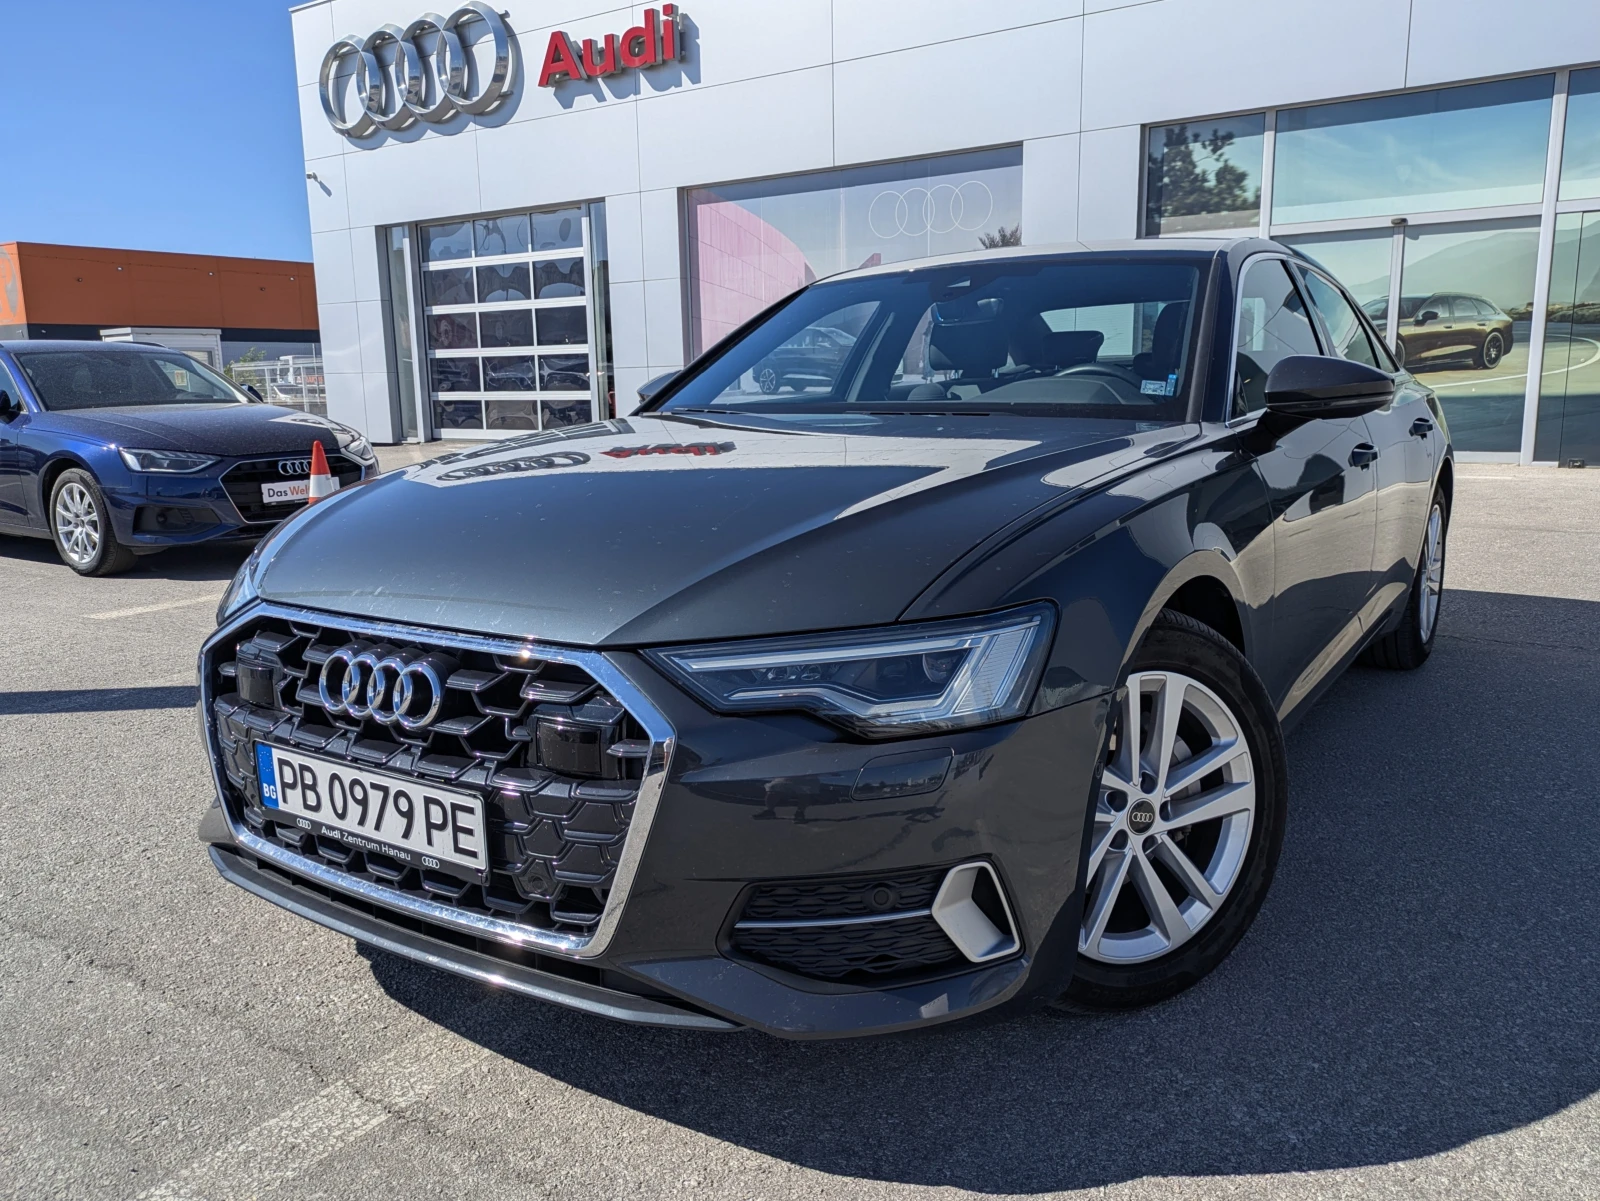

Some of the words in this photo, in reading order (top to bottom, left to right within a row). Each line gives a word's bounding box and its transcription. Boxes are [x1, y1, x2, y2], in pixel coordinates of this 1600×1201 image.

[538, 3, 678, 87] Audi
[267, 487, 288, 498] Das
[289, 484, 310, 496] Wel
[263, 782, 277, 800] BG
[277, 757, 321, 813] PB
[328, 772, 414, 840] 0979
[423, 795, 479, 860] PE
[321, 825, 341, 839] Audi
[342, 832, 380, 852] Zentrum
[381, 843, 411, 860] Hanau
